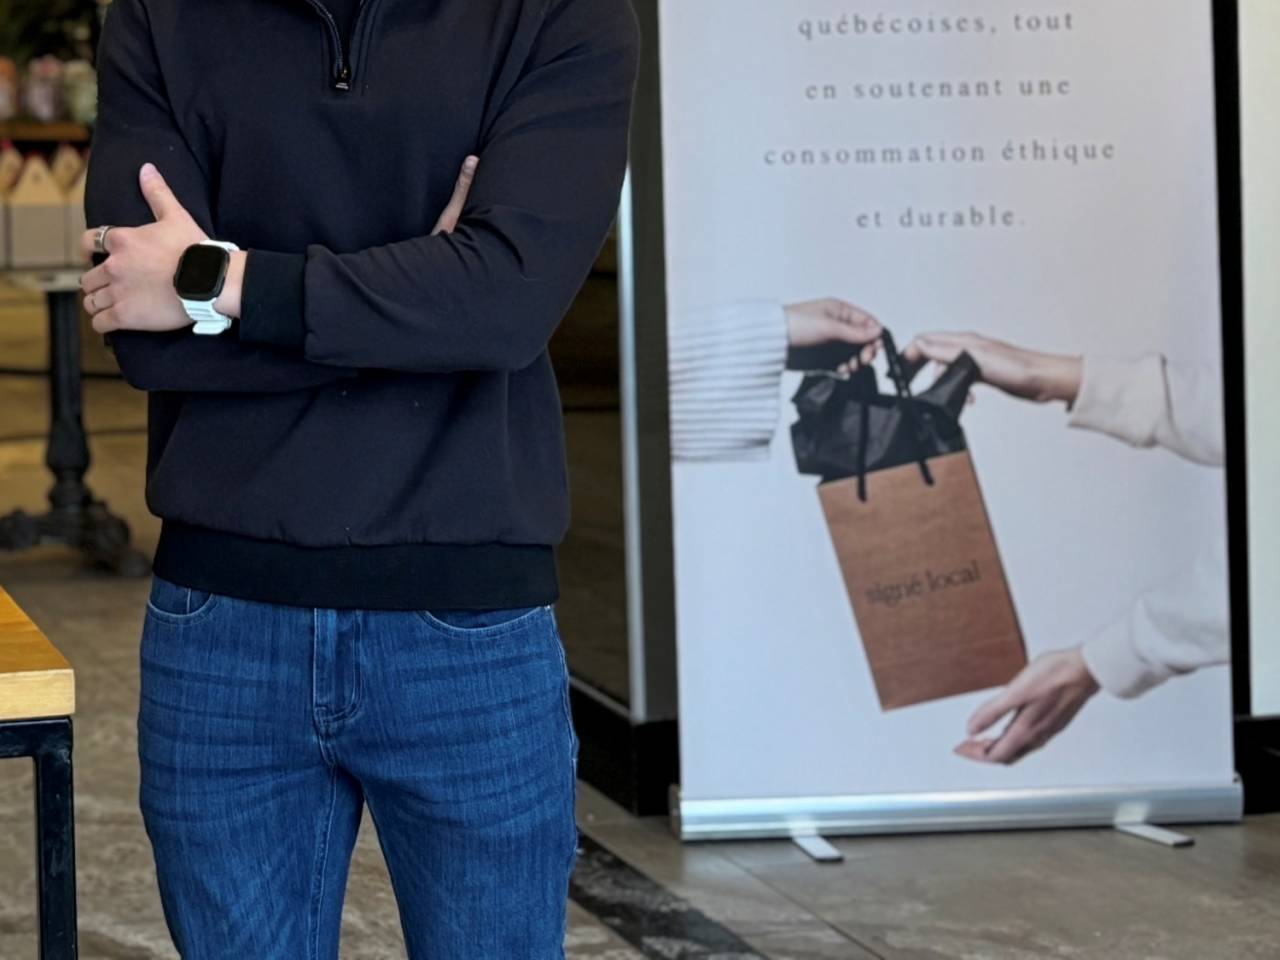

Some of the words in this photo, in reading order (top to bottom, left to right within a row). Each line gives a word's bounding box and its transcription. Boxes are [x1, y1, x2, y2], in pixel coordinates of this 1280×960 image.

[797, 13, 998, 41] québécoises,
[1013, 12, 1074, 32] tout
[804, 83, 837, 101] en
[853, 79, 1003, 100] soutenant
[1018, 78, 1071, 98] une
[763, 144, 986, 166] consommation
[1001, 140, 1115, 166] éthique
[855, 210, 883, 229] et
[866, 573, 924, 607] signé
[924, 559, 981, 593] local
